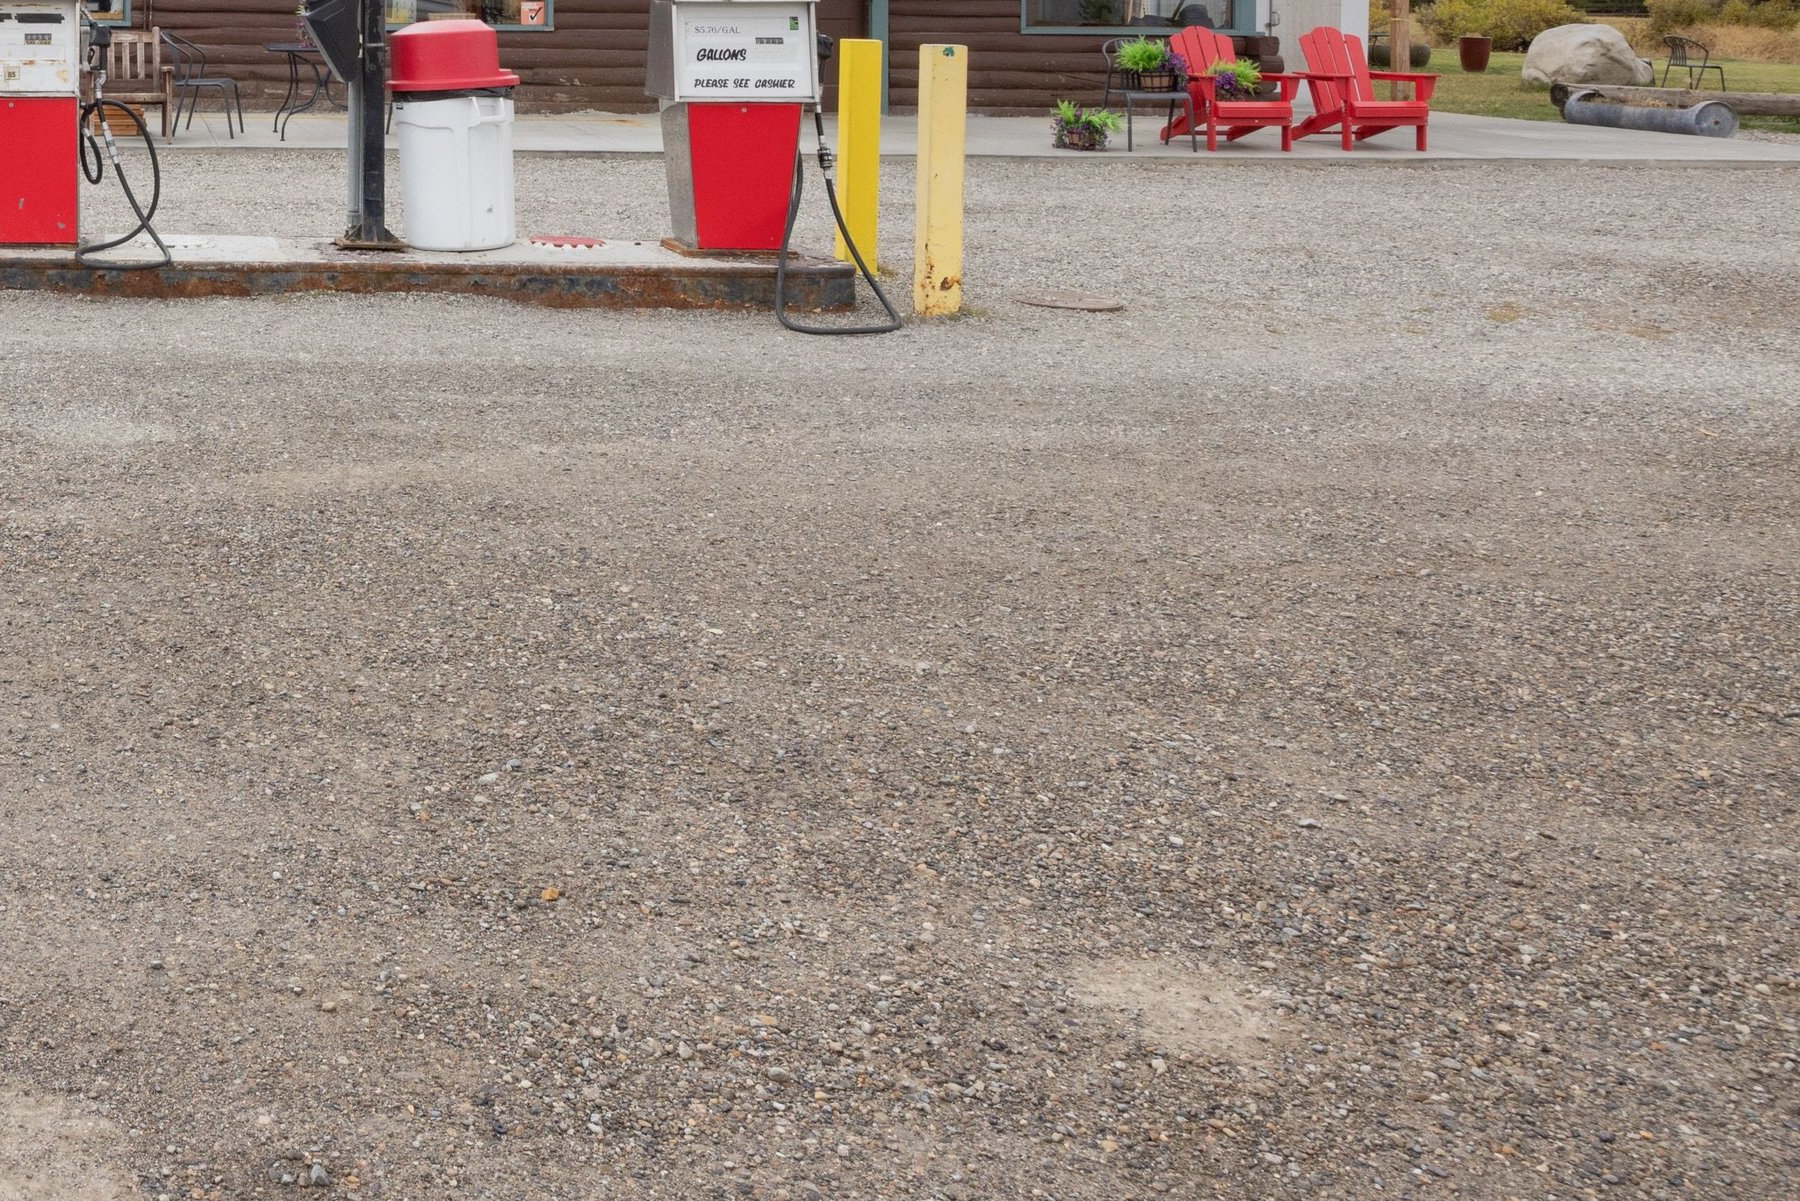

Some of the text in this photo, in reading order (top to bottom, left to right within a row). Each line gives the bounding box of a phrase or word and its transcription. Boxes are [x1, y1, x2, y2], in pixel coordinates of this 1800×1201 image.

[694, 26, 741, 34] $5.76/GAL
[696, 48, 747, 61] GALLONS
[694, 78, 796, 88] PLEASE SEE CASHIER
